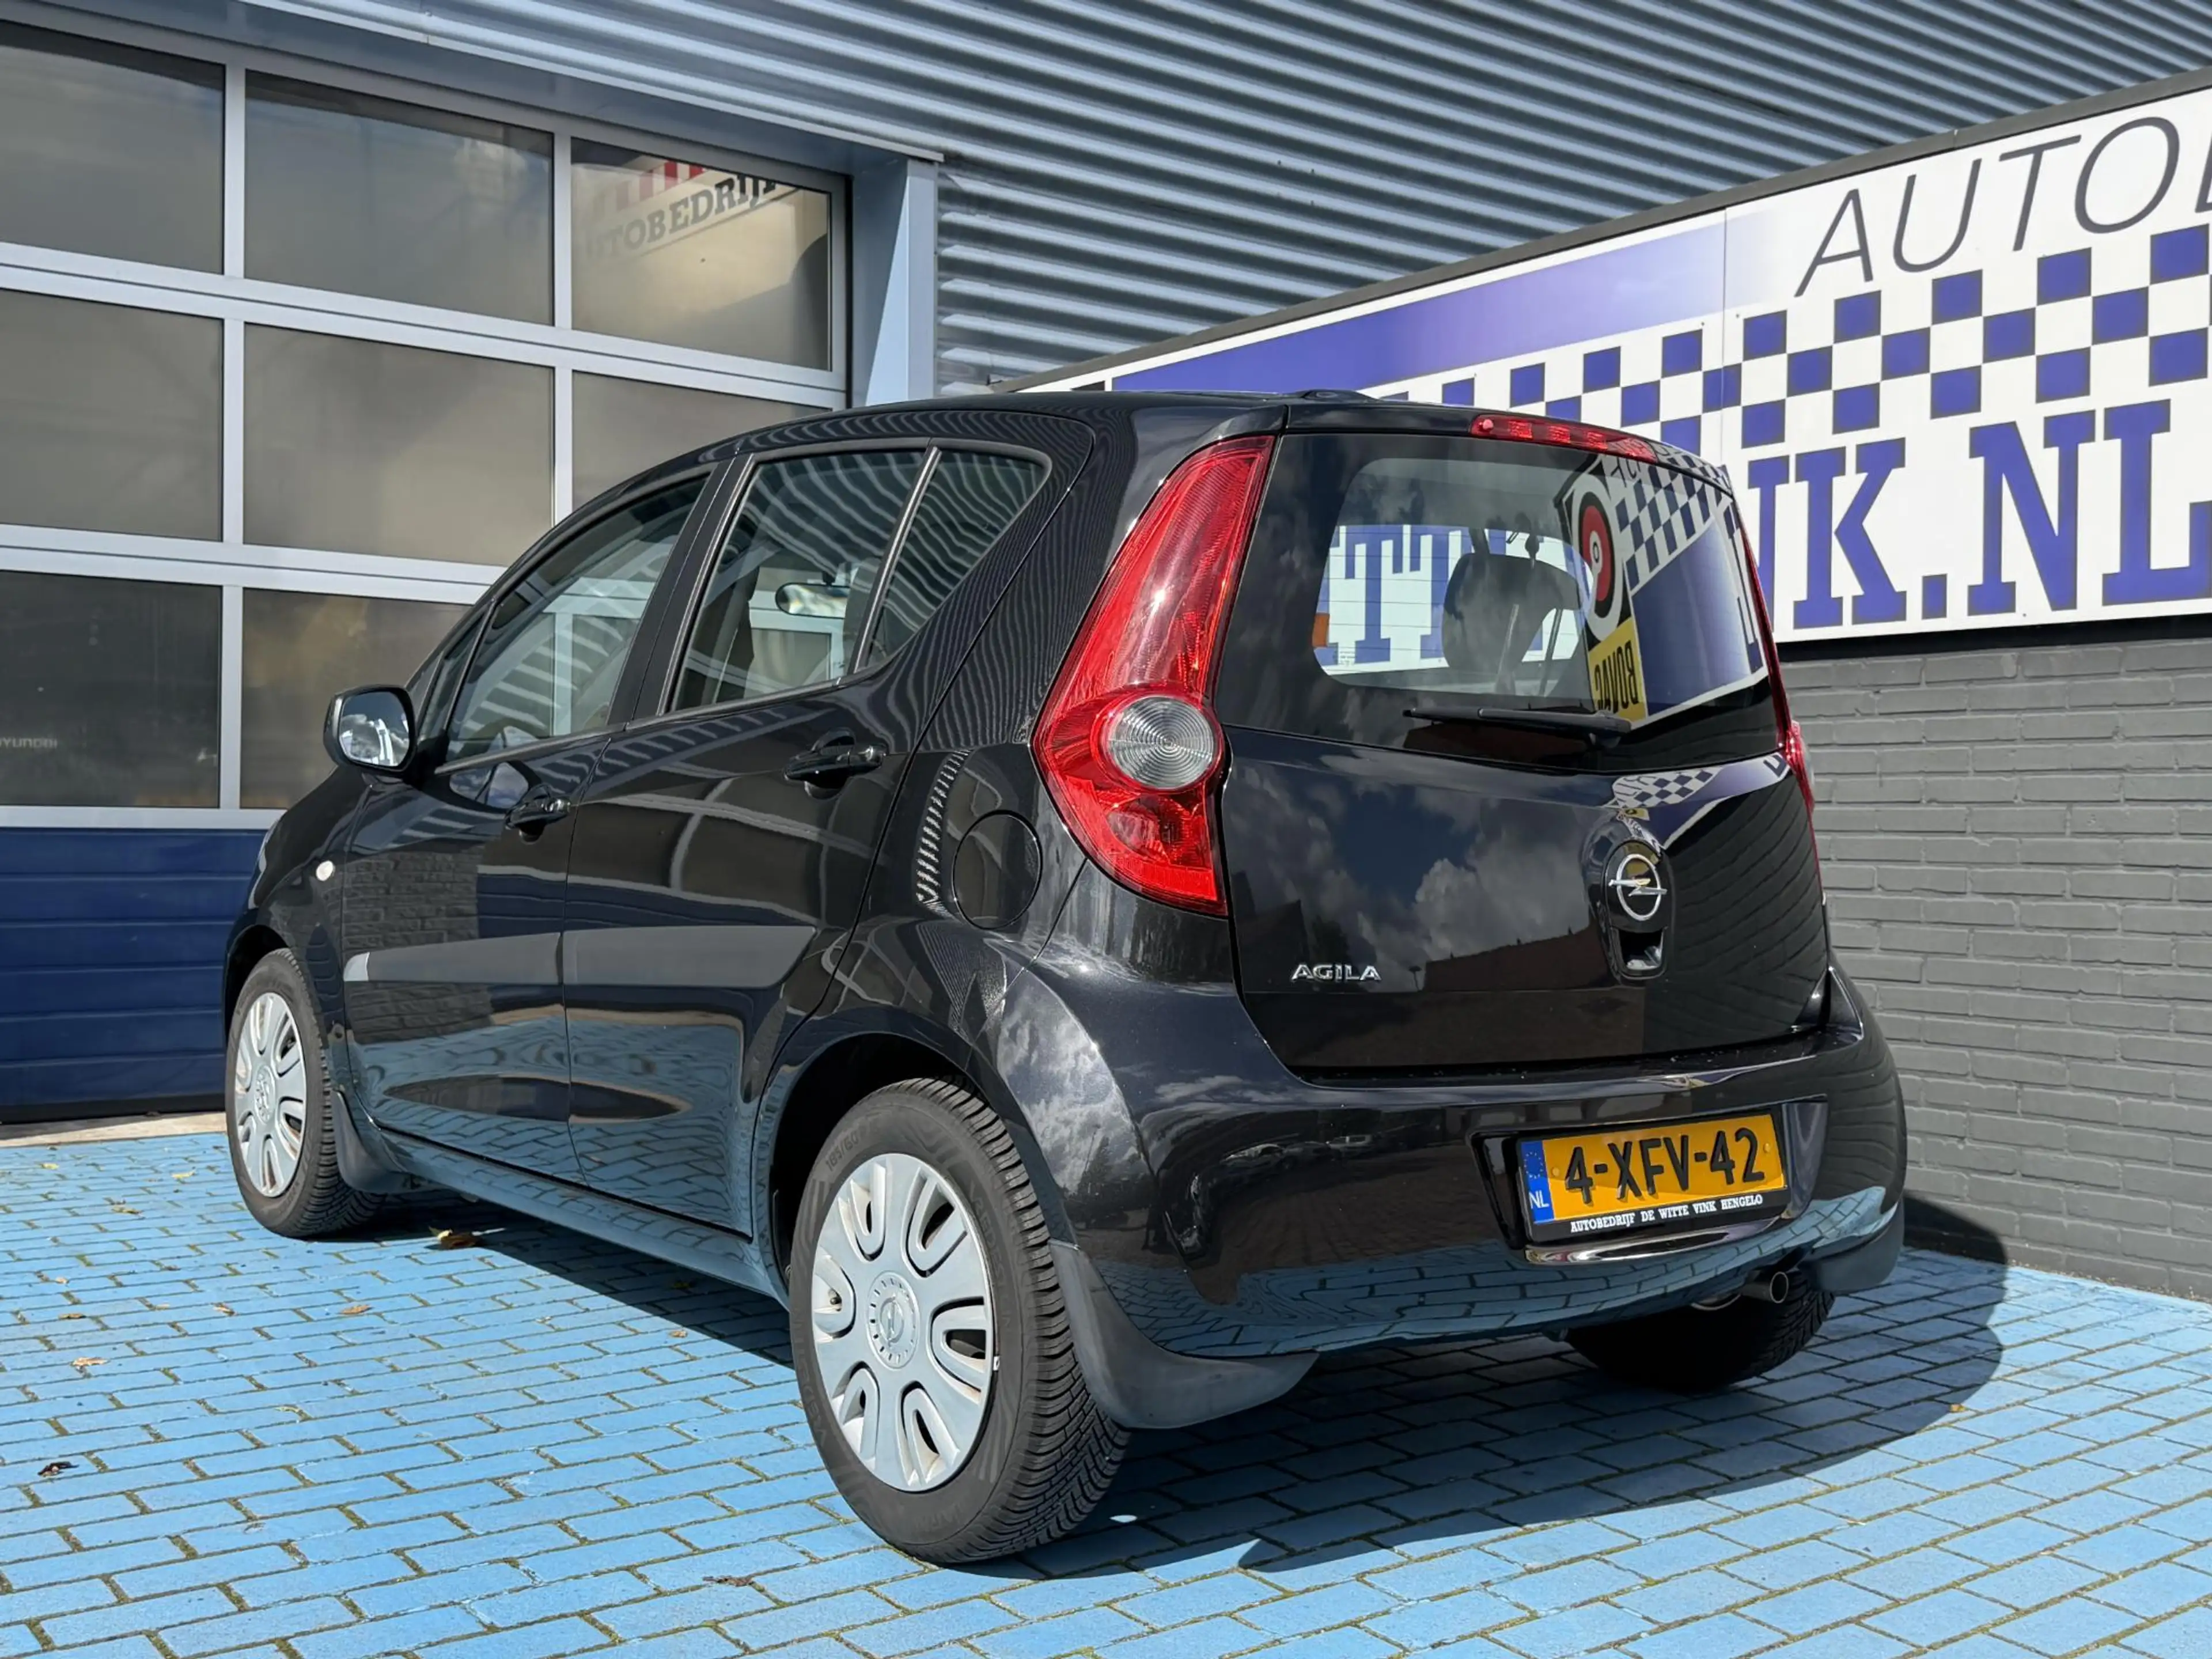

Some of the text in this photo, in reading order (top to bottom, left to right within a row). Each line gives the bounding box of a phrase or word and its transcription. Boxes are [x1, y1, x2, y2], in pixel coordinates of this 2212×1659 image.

[1794, 116, 2212, 297] AUTO
[1290, 963, 1382, 983] AGILA
[1565, 1127, 1766, 1205] 4-XFV-42
[1529, 1191, 1550, 1209] NL
[1570, 1194, 1763, 1233] AUTOBEDRIJF DE WITTE VINK HENGELO
